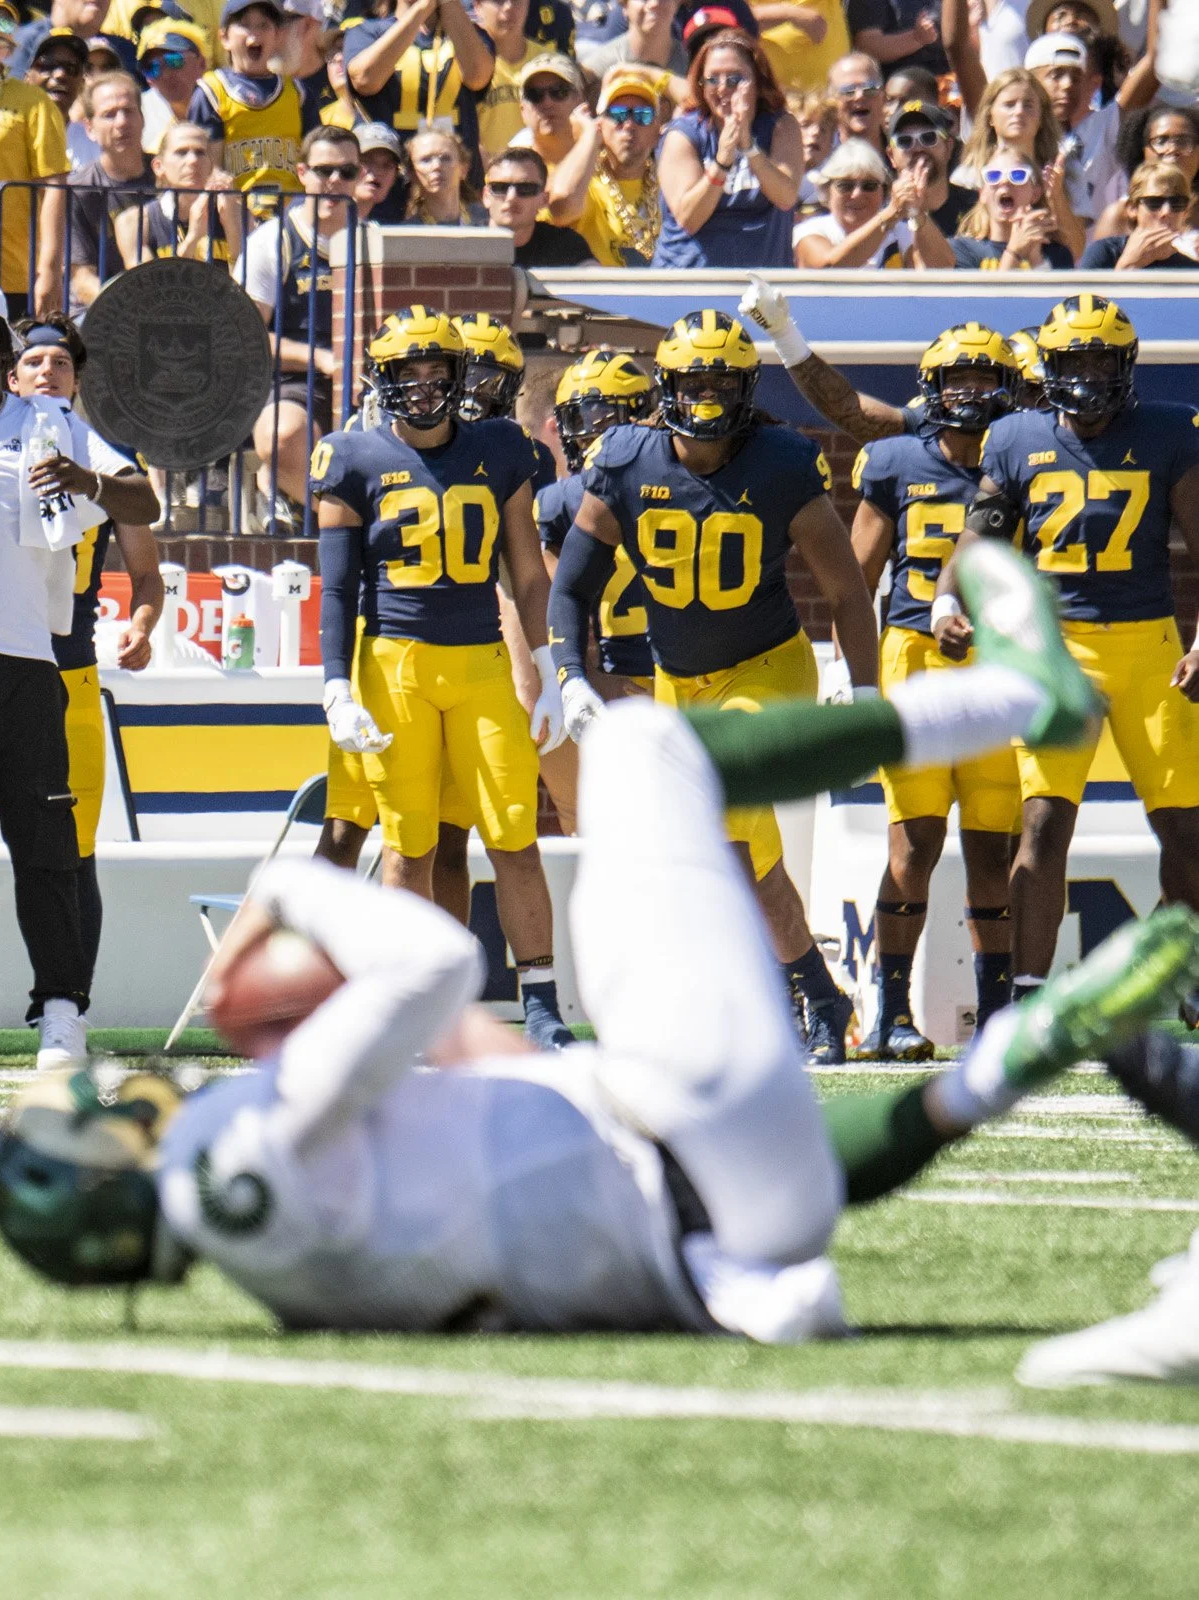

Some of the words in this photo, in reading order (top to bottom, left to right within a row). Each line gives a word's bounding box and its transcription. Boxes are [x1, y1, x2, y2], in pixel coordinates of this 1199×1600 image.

[379, 485, 500, 588] 30
[638, 508, 764, 611] 90
[906, 501, 966, 602] 5
[1029, 470, 1151, 574] 27
